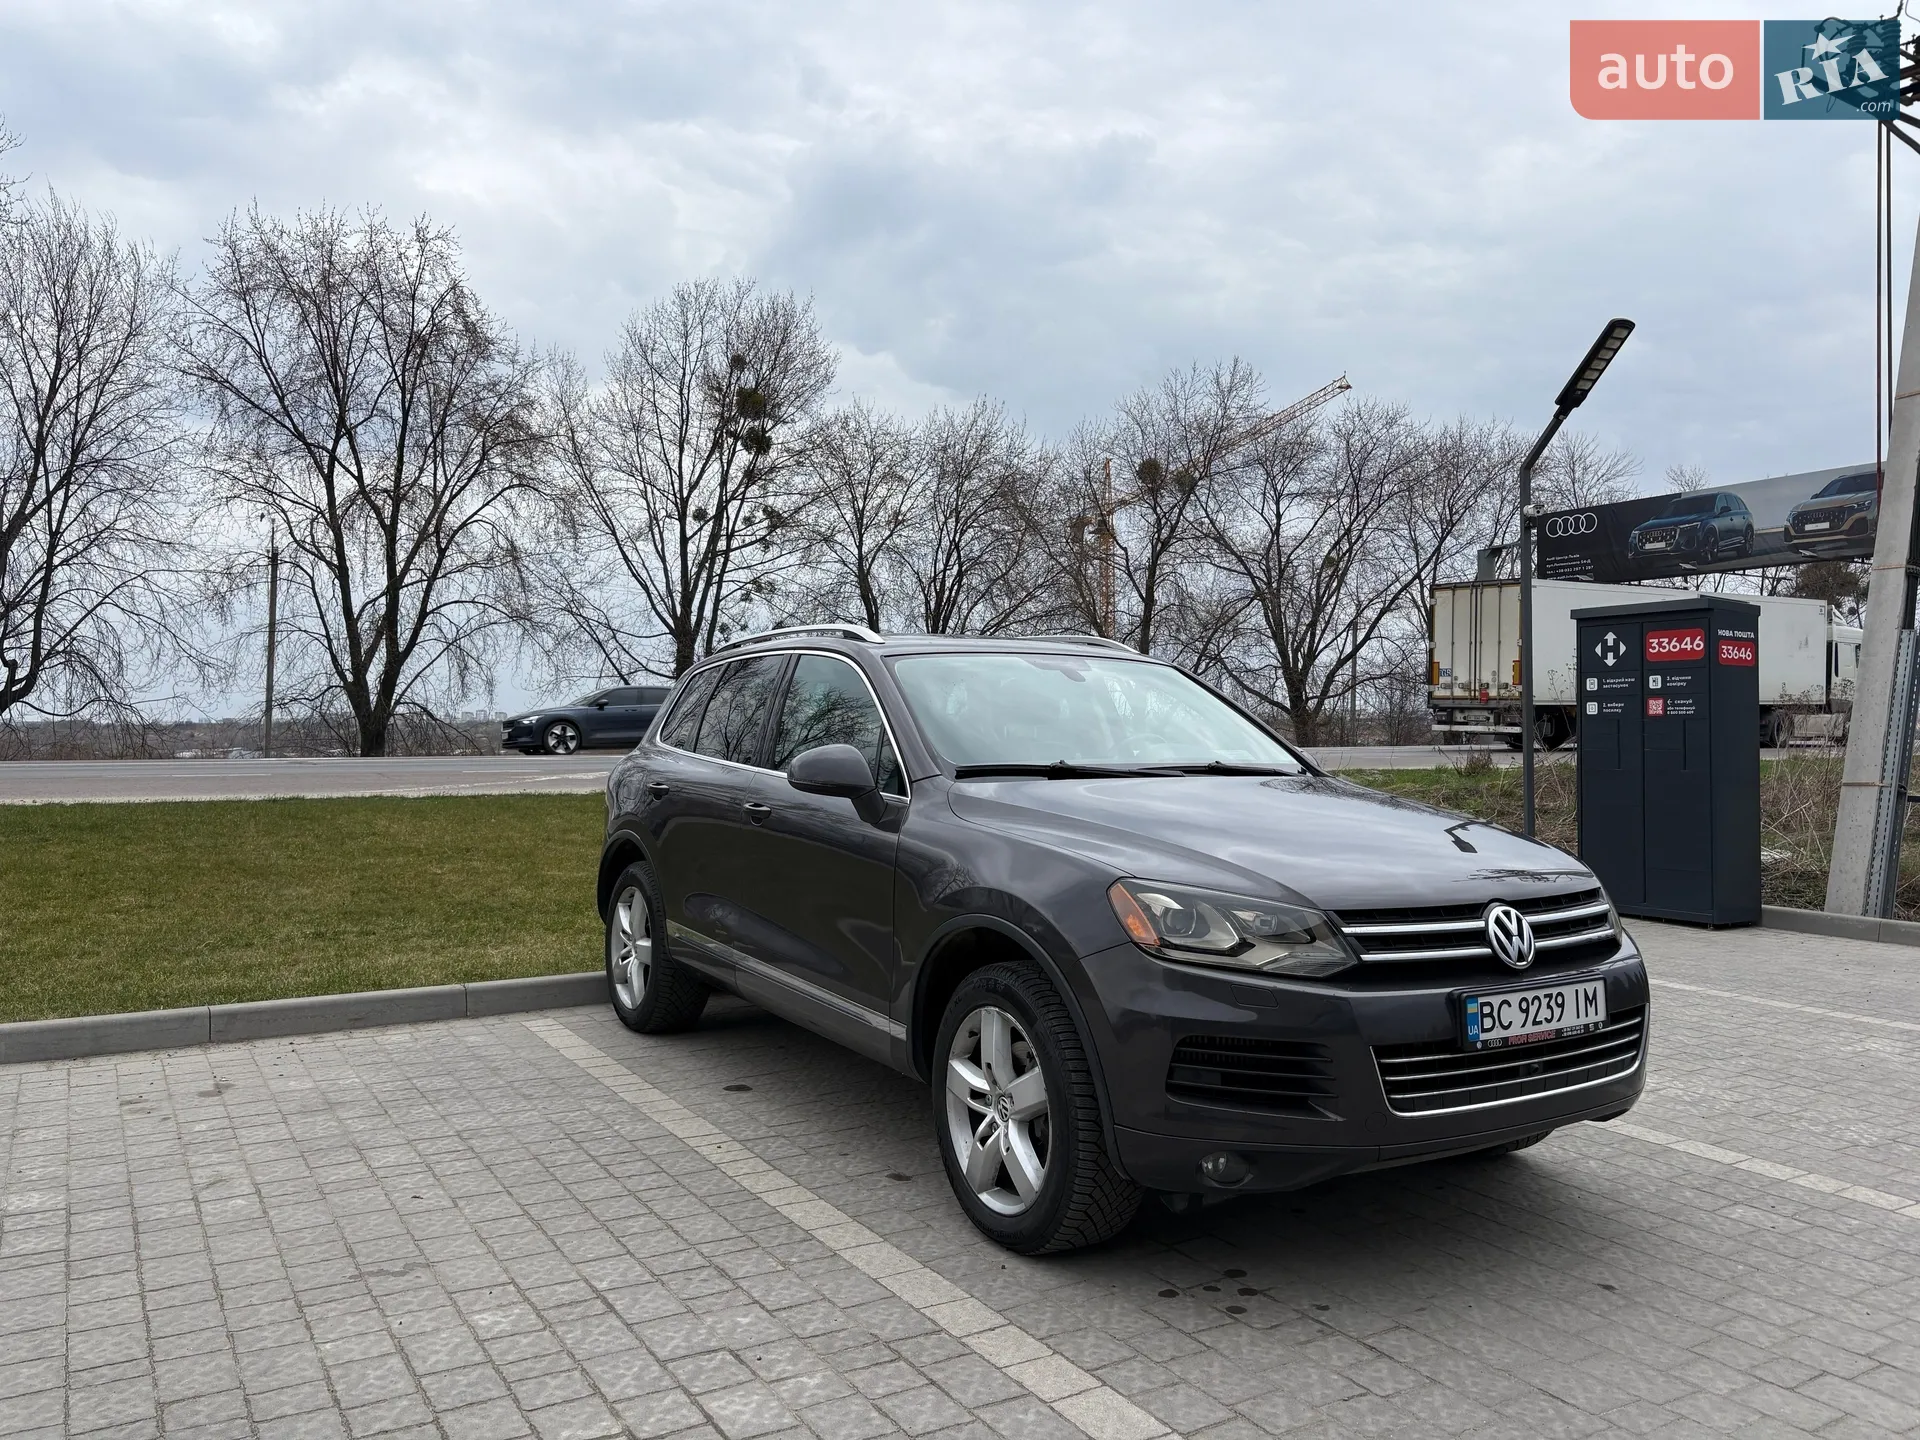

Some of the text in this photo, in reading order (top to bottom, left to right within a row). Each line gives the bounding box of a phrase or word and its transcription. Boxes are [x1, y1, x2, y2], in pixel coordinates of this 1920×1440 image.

[1717, 629, 1755, 638] НОВА ПОШТА
[1648, 635, 1704, 653] 33646
[1721, 645, 1752, 660] 33646
[1480, 986, 1599, 1034] BC 9239 IM
[1468, 1025, 1479, 1036] UA
[1528, 1030, 1556, 1042] SERVICE
